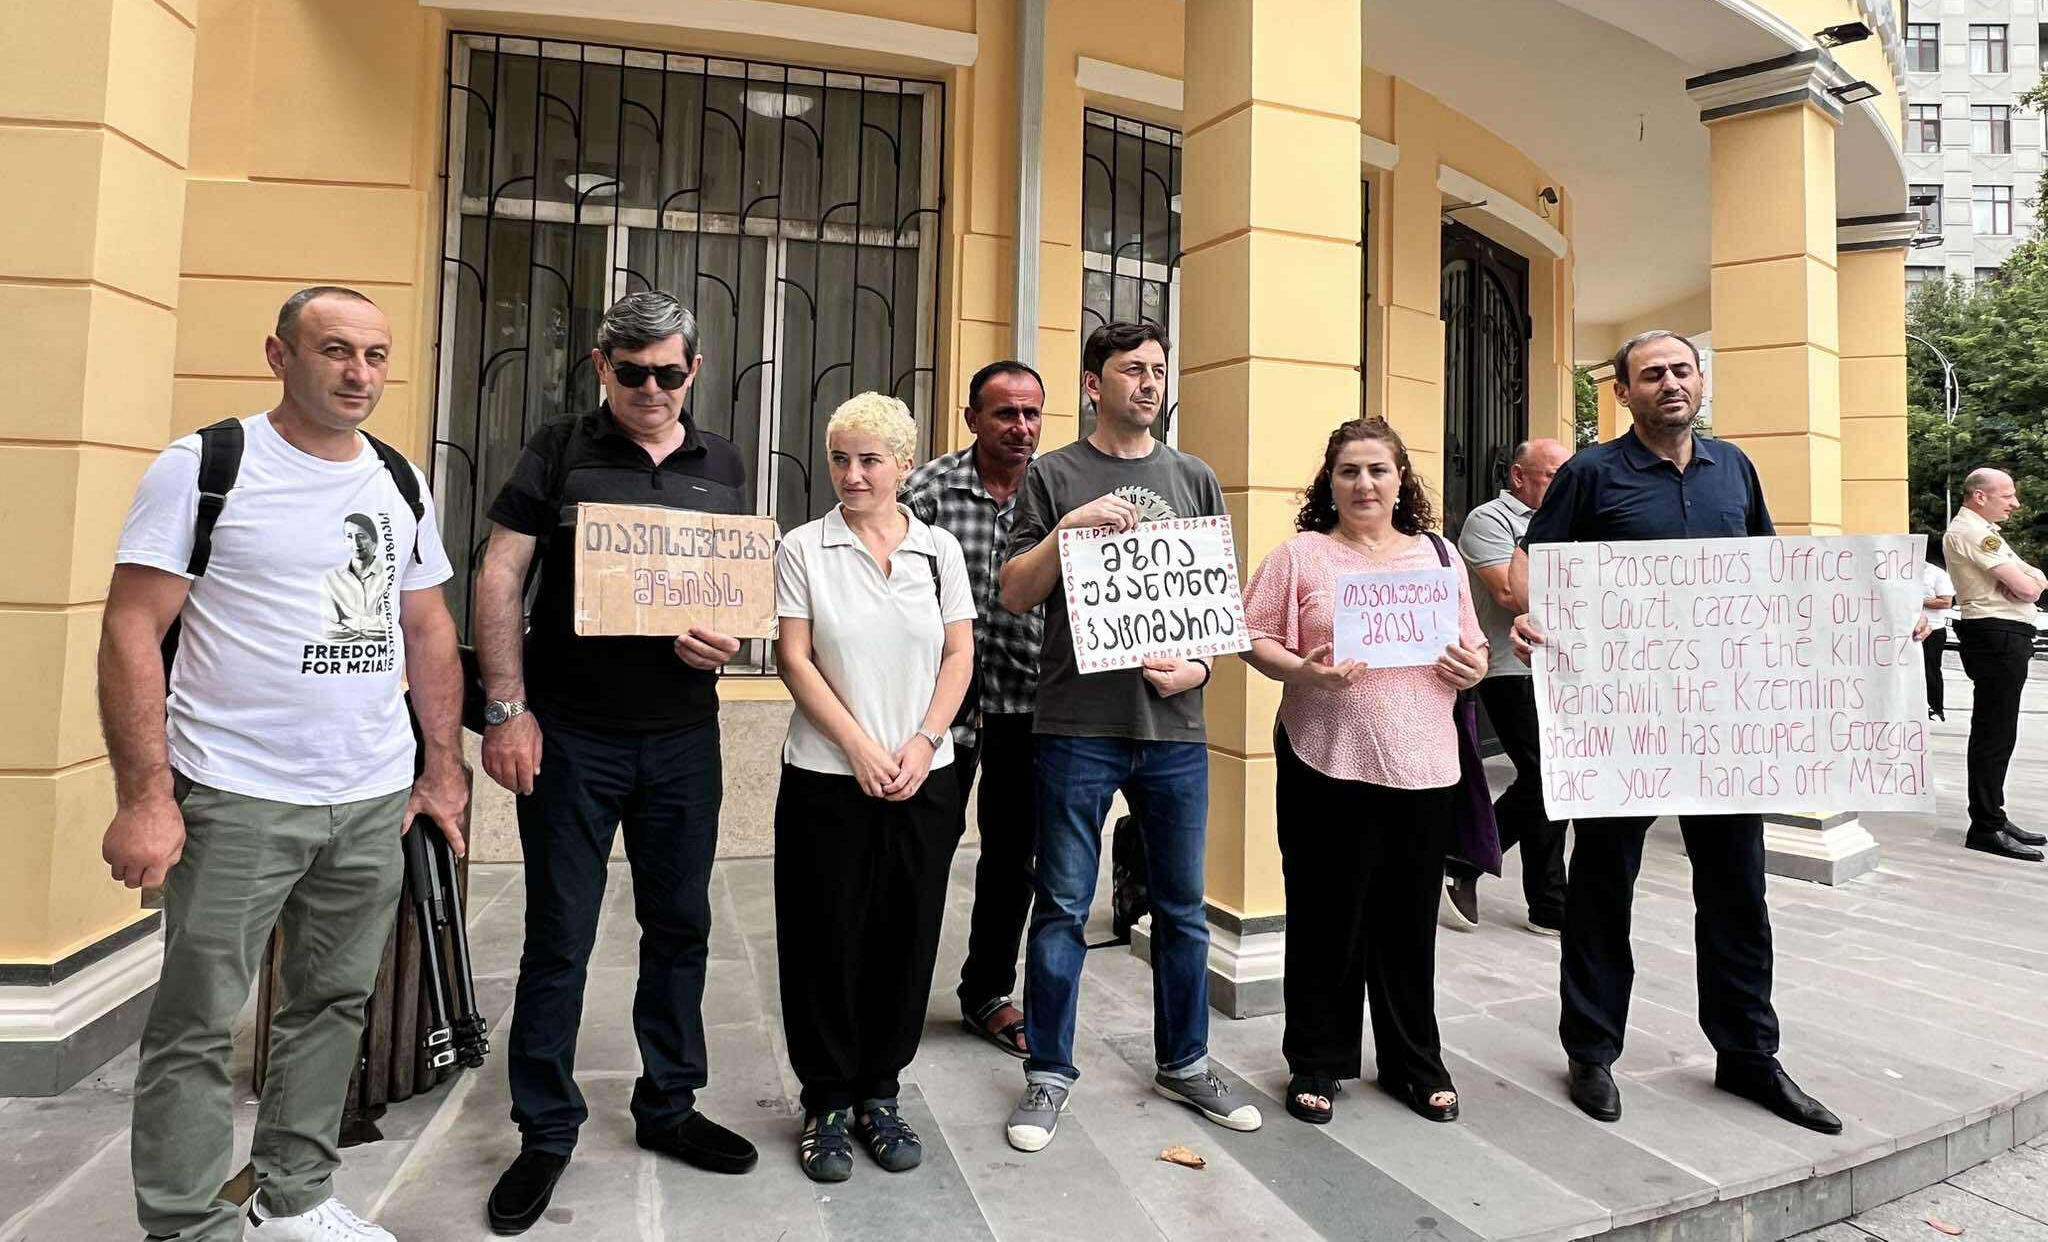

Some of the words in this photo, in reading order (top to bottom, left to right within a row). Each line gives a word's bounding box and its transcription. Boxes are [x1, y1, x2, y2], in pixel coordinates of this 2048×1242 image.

[585, 521, 771, 560] თავისუფლება
[1160, 519, 1208, 531] MEDIA
[1101, 537, 1195, 572] მზია
[1535, 548, 1585, 589] The
[1598, 542, 1751, 587] Prosecutor's
[1769, 538, 1853, 583] Office
[1874, 543, 1915, 581] and
[634, 568, 744, 607] მზიას
[1081, 567, 1228, 606] უკანონო
[1343, 580, 1448, 608] თავისუფლება
[1541, 594, 1588, 631] the
[1693, 593, 1813, 632] carrying
[1832, 589, 1882, 625] out
[301, 661, 341, 675] FOR
[346, 659, 387, 674] MZIA!
[303, 644, 387, 660] FREEDOM
[1100, 656, 1126, 668] SOS
[1541, 637, 1588, 673] the
[1600, 637, 1701, 673] orders
[1721, 635, 1752, 669] of
[1760, 630, 1813, 668] the
[1672, 676, 1719, 714] the
[1734, 669, 1865, 712] Kremlin's
[1546, 719, 1616, 759] shadow
[1681, 720, 1720, 756] has
[1731, 716, 1816, 760] occupied
[1546, 764, 1599, 802] take
[1617, 766, 1673, 807] your
[1700, 760, 1780, 797] hands
[1795, 759, 1835, 796] off
[1849, 753, 1928, 797] Mzia!
